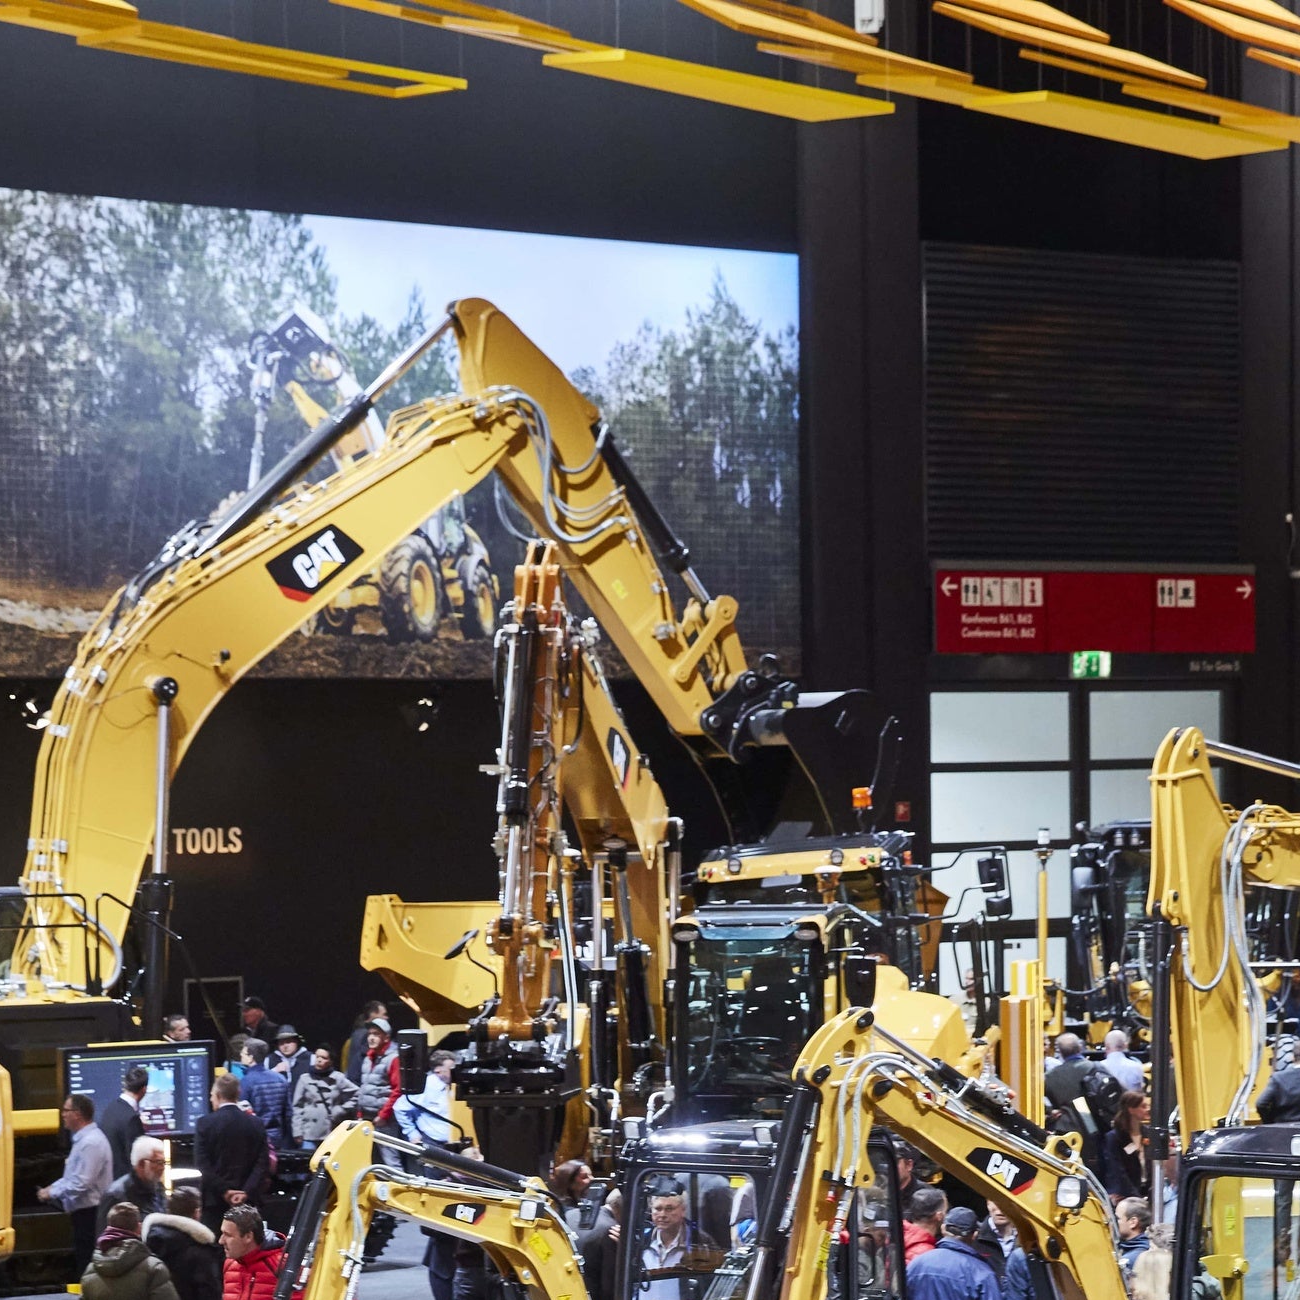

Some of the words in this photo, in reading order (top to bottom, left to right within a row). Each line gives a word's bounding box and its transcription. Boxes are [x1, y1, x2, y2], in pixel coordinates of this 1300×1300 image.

[292, 529, 345, 588] CAT
[173, 826, 243, 855] TOOLS
[987, 1153, 1020, 1188] CAT
